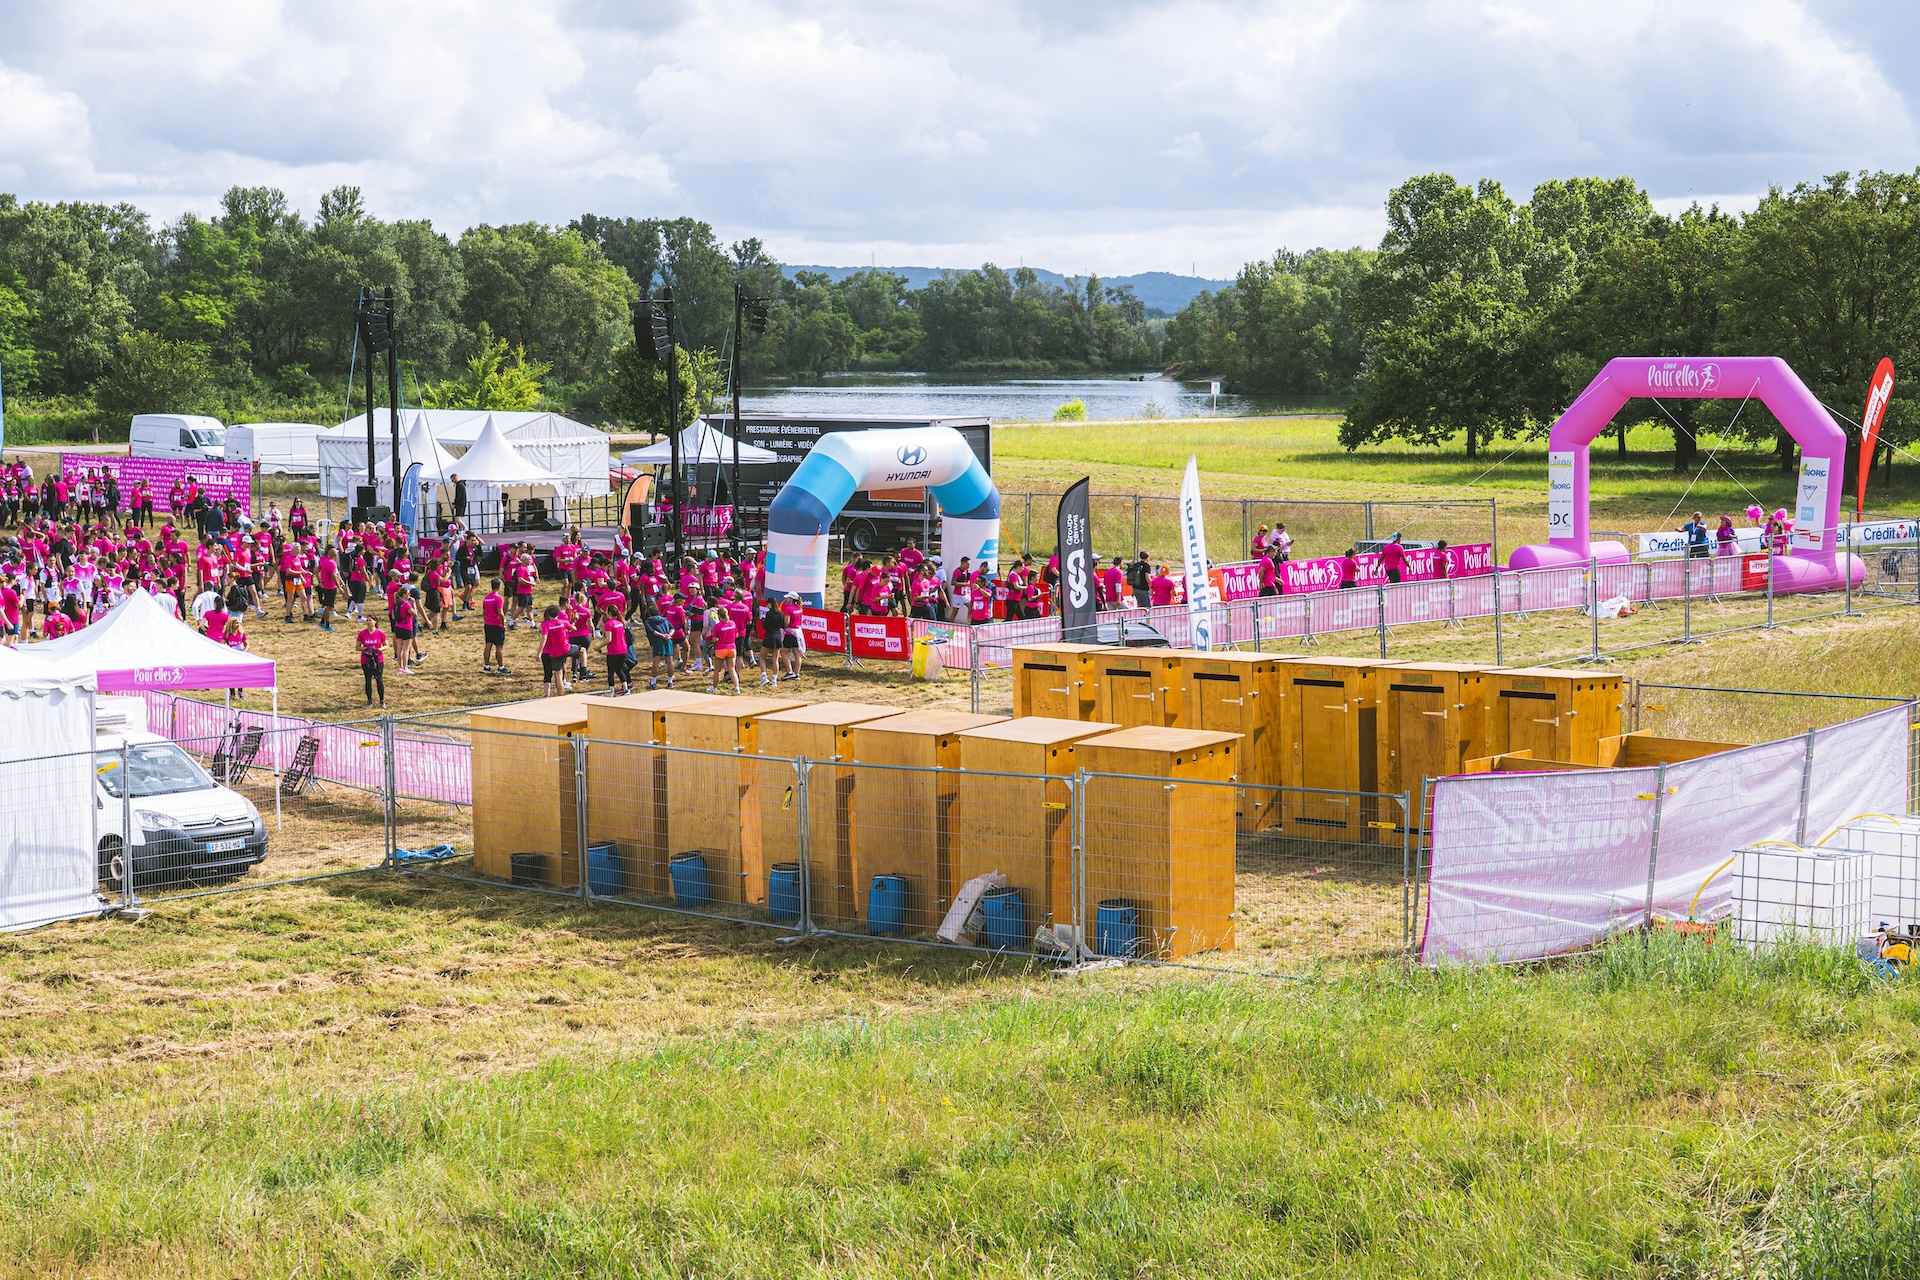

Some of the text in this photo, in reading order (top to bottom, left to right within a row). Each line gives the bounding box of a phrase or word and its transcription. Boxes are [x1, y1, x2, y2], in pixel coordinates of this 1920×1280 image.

[745, 425, 780, 435] PRESTATAIRE
[753, 439, 766, 448] SON
[769, 438, 794, 449] LUMIÈRE
[209, 476, 233, 486] ELLES
[885, 470, 932, 482] HYUNDAI
[1863, 527, 1896, 541] Crédit
[1649, 538, 1685, 552] Crédit
[868, 639, 885, 648] GRAND
